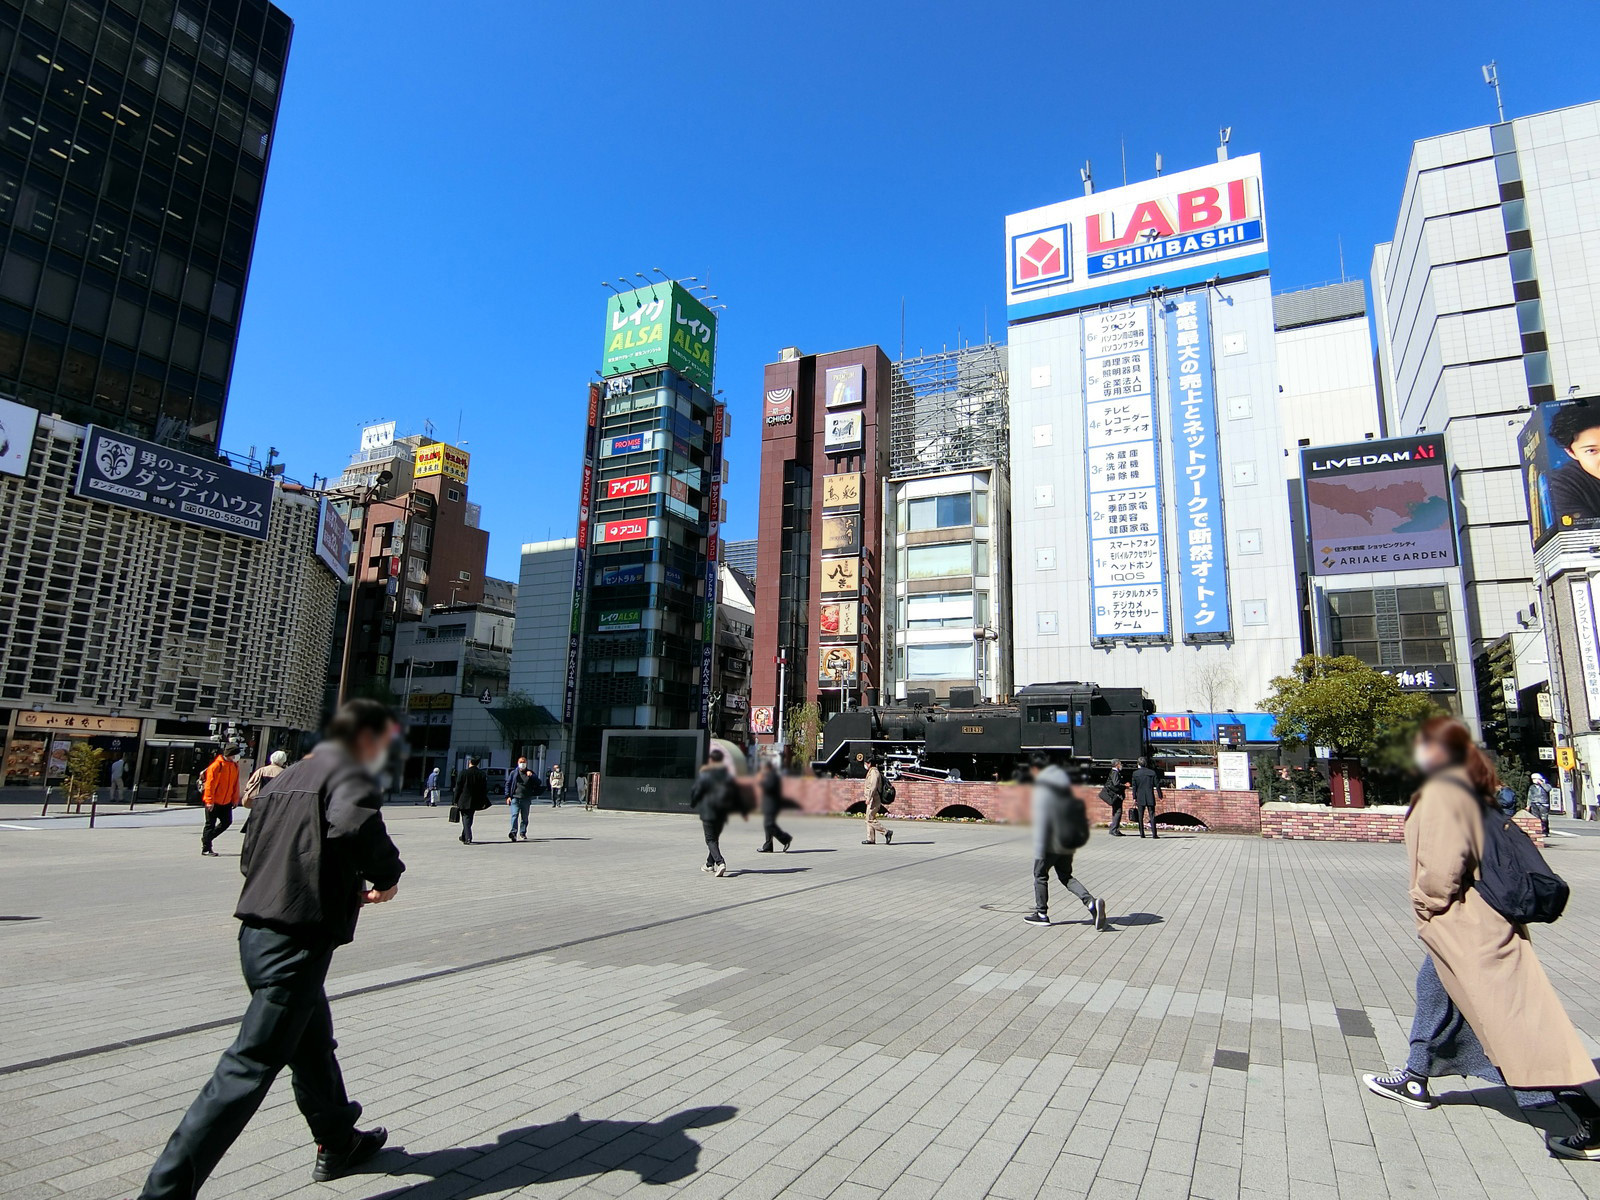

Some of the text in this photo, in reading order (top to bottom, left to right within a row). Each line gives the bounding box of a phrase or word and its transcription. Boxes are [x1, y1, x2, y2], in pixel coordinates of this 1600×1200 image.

[1085, 179, 1247, 253] LABI
[1101, 225, 1245, 270] SHIMBASHI
[612, 299, 665, 332] レイク
[1101, 311, 1136, 324] パソコン
[675, 303, 711, 344] レイク
[608, 322, 663, 353] ALSA
[1087, 332, 1099, 342] 6F
[672, 328, 710, 368] ALSA
[1102, 354, 1141, 368] 調理家電
[1102, 364, 1141, 378] 照明器具
[1088, 375, 1100, 386] 5F
[1103, 375, 1142, 389] 企業法人
[1103, 384, 1142, 397] 専用窓口
[1104, 404, 1131, 416] テレビ
[766, 414, 791, 424] ICHIGO
[1089, 419, 1101, 429] 4F
[1104, 413, 1149, 426] レコーダー
[1104, 423, 1149, 436] オーディオ
[615, 438, 641, 449] PROMISE
[1105, 449, 1139, 461] 冷蔵庫
[1413, 444, 1435, 459] Ai
[140, 450, 220, 484] 男のエステ
[1091, 465, 1103, 475] 3F
[1106, 460, 1139, 471] 洗濯機
[1106, 470, 1140, 482] 掃除機
[92, 480, 143, 499] ダンディハウス
[135, 468, 264, 518] ダンディハウス
[611, 479, 648, 495] アイフル
[1108, 491, 1147, 502] エアコン
[1108, 501, 1148, 513] 季節家電
[197, 506, 259, 531] 0120-552-011
[1093, 511, 1105, 521] 2F
[1108, 513, 1138, 524] 理美容
[619, 524, 642, 536] アコム
[1108, 522, 1149, 535] 健康家電
[1110, 539, 1156, 550] スマートフォン
[1334, 541, 1416, 553] 住友不動産 ショッピングシティ
[1110, 549, 1158, 561] モバイルアクセサリー
[1340, 550, 1448, 566] ARIAKE GARDEN
[1095, 558, 1107, 568] 1F
[1110, 561, 1153, 571] ヘッドホン
[606, 574, 635, 585] セントラル
[1112, 588, 1159, 600] デジタルカメラ
[1113, 600, 1143, 611] デジカメ
[601, 612, 639, 622] レイク ALSA
[1113, 608, 1159, 619] アクセサリー
[1114, 620, 1142, 630] ゲーム
[1150, 716, 1190, 731] ABI
[640, 783, 657, 794] FUJITSU
